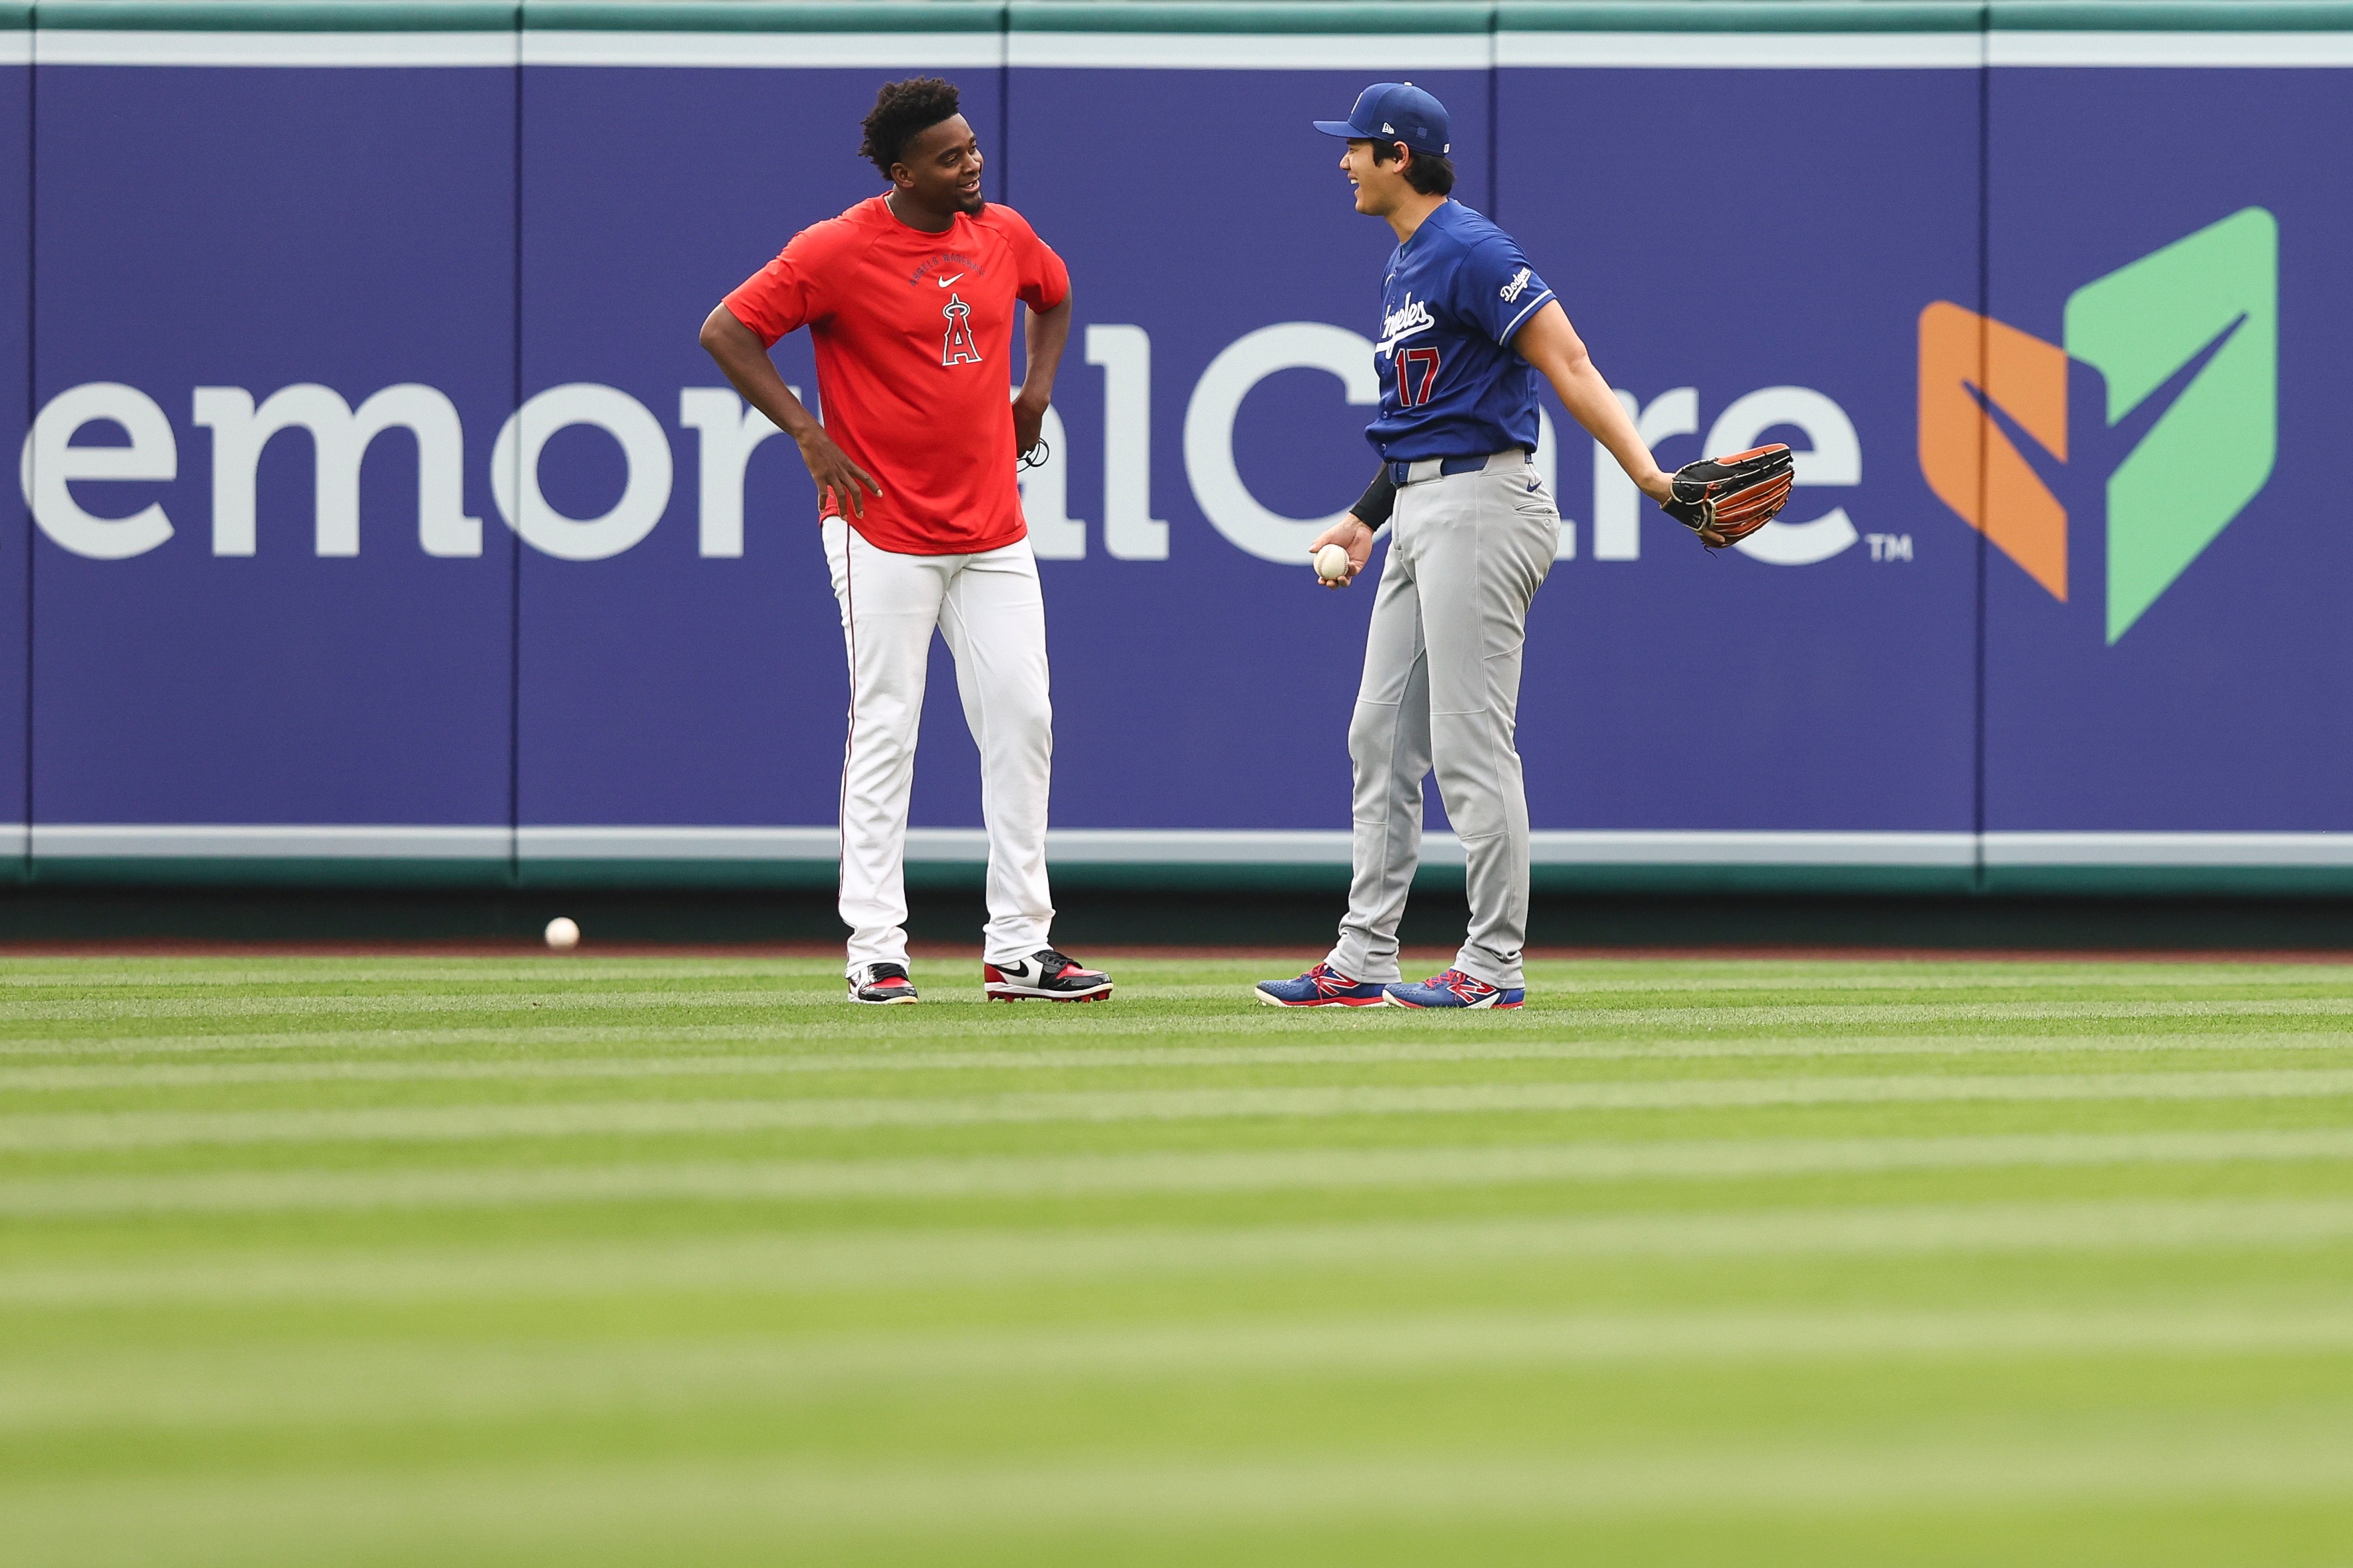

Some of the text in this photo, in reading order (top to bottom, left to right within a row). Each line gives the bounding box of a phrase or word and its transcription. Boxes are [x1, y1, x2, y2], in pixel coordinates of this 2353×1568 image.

[1500, 267, 1531, 303] Dodgers
[942, 292, 983, 367] A
[1375, 291, 1435, 360] ngeles
[1394, 346, 1441, 408] 17
[1865, 533, 1913, 562] TM
